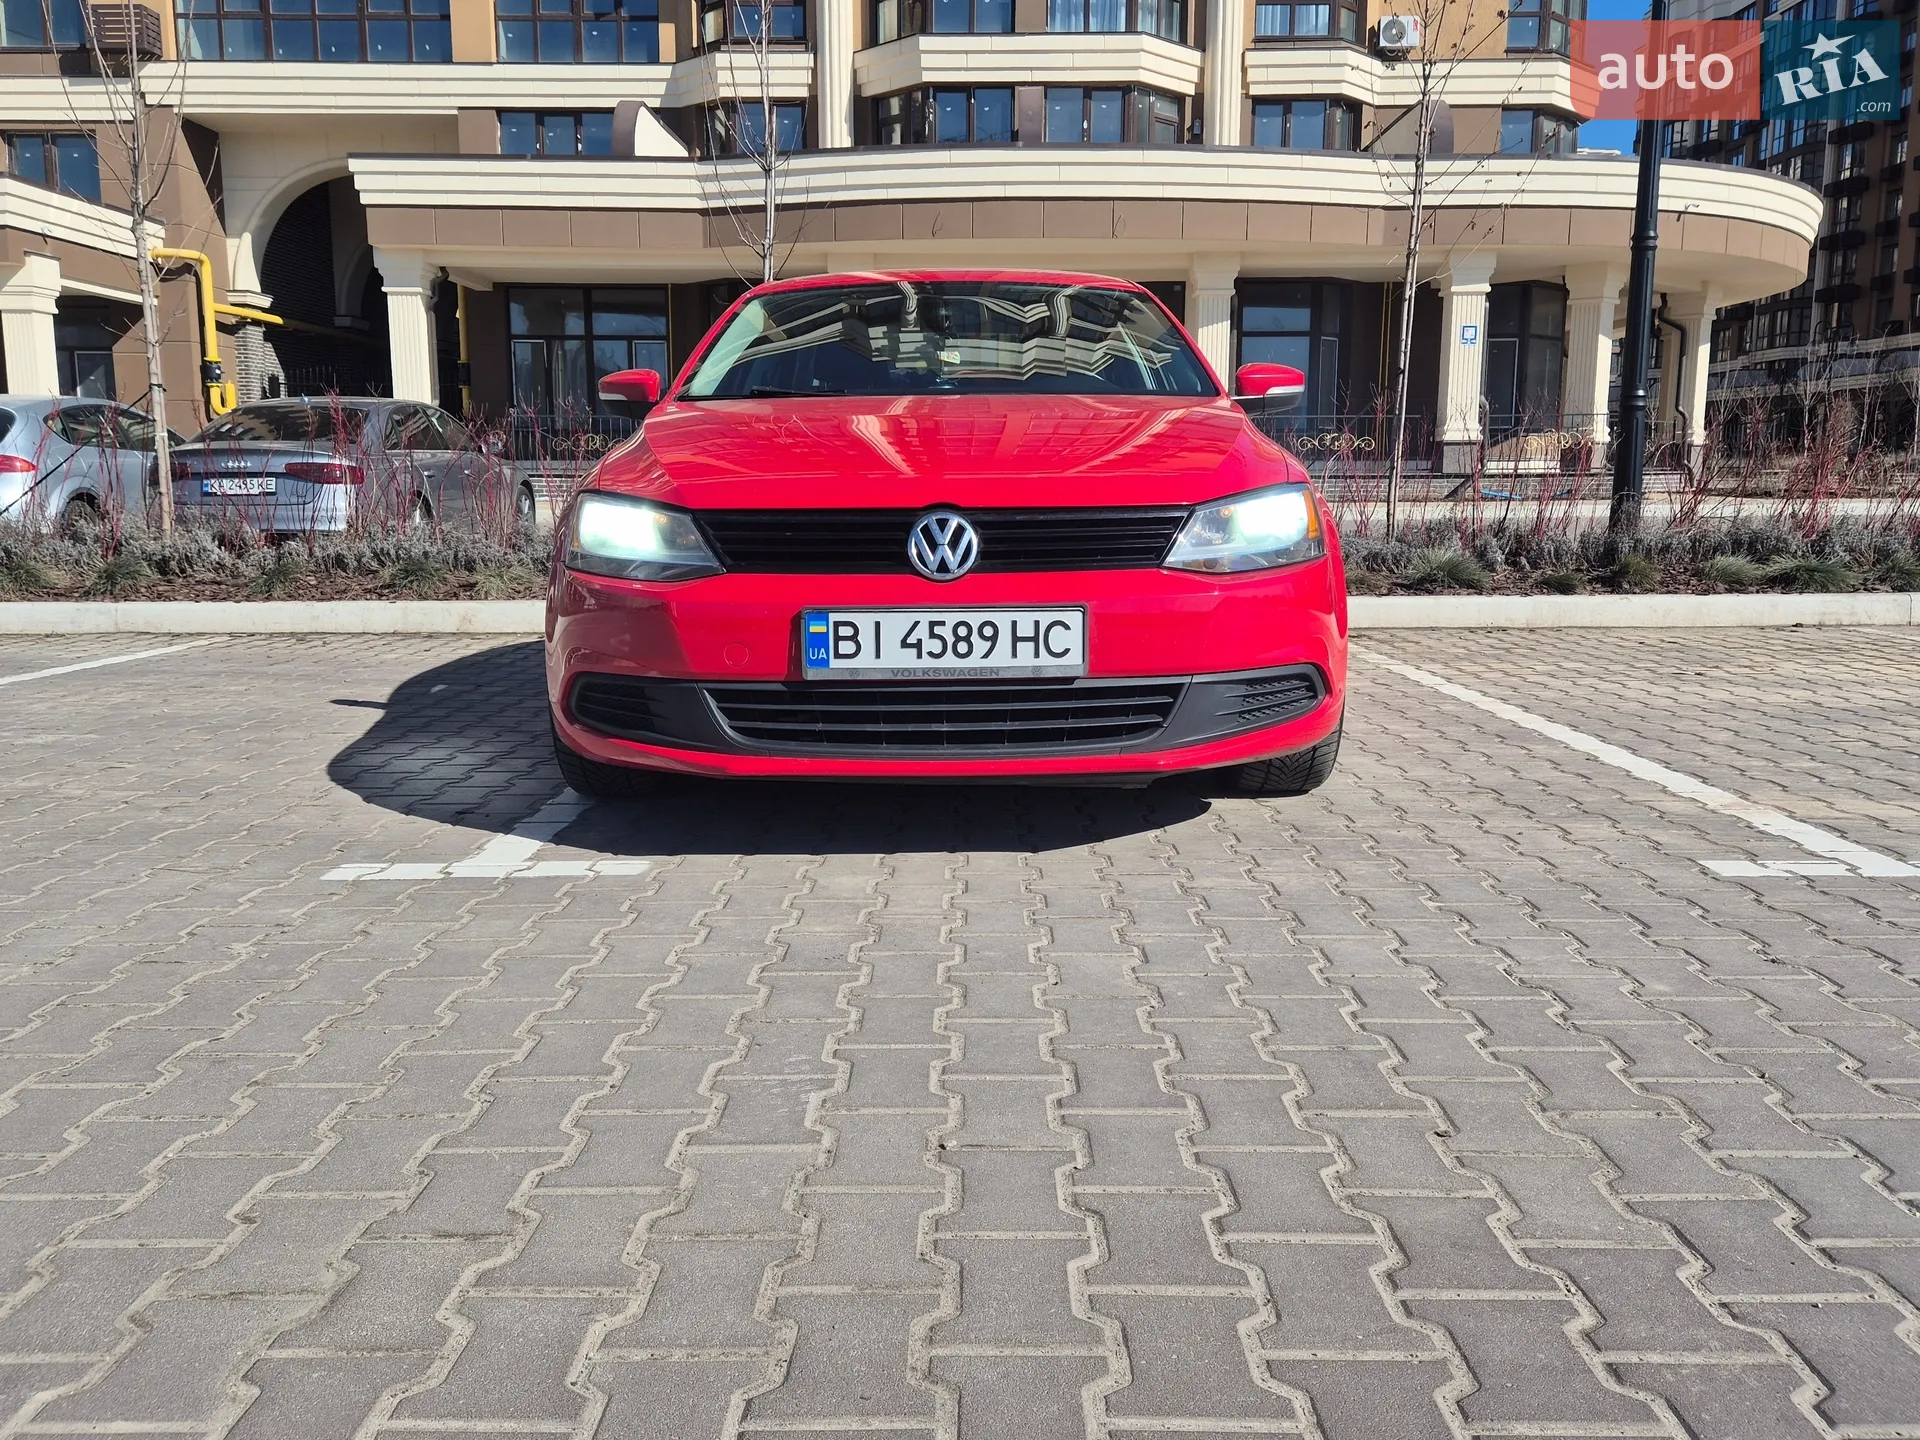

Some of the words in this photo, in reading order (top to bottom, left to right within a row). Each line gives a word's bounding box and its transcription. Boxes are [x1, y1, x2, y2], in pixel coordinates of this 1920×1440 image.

[257, 479, 274, 490] KE
[832, 620, 881, 660] BI
[900, 620, 1000, 660] 4589
[1011, 619, 1072, 659] HC
[809, 649, 827, 660] UA
[891, 668, 1000, 678] VOLKSWAGEN
